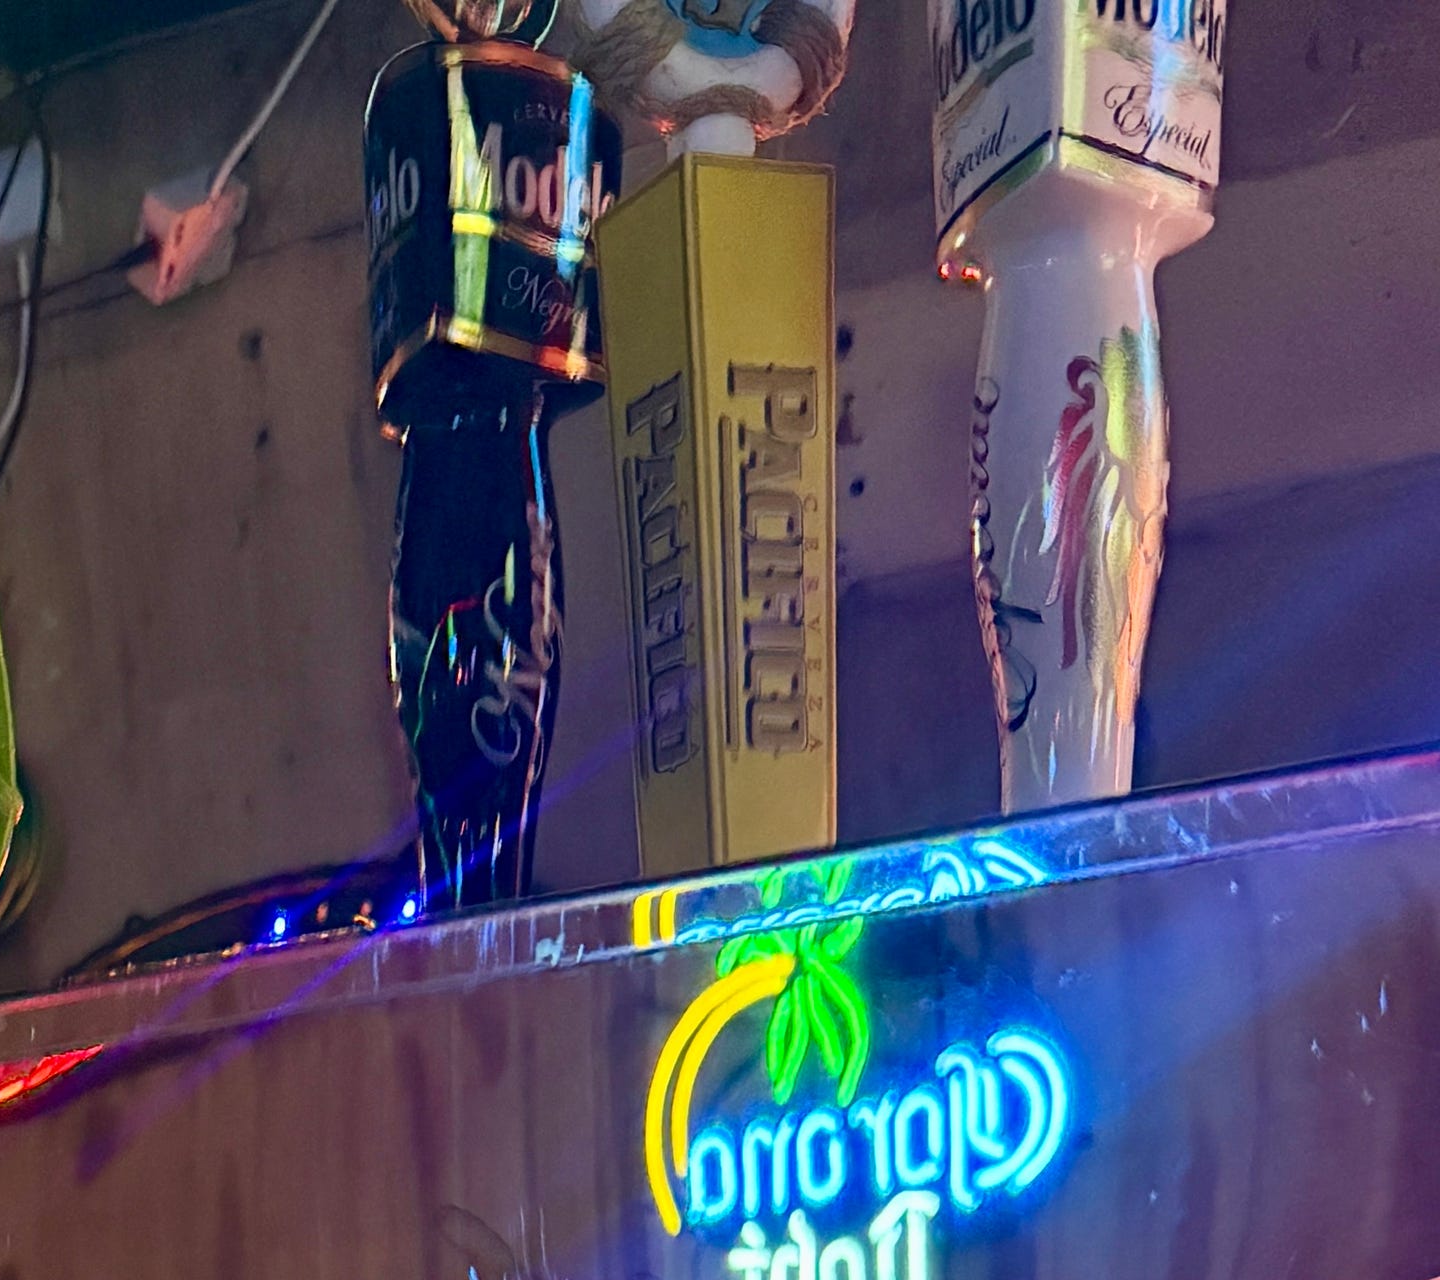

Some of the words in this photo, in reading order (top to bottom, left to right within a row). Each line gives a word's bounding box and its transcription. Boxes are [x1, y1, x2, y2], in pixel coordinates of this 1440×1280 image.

[449, 121, 616, 238] Model
[1104, 84, 1211, 169] Especial
[627, 370, 690, 775] PACIFICO
[727, 361, 818, 752] PACIFICO
